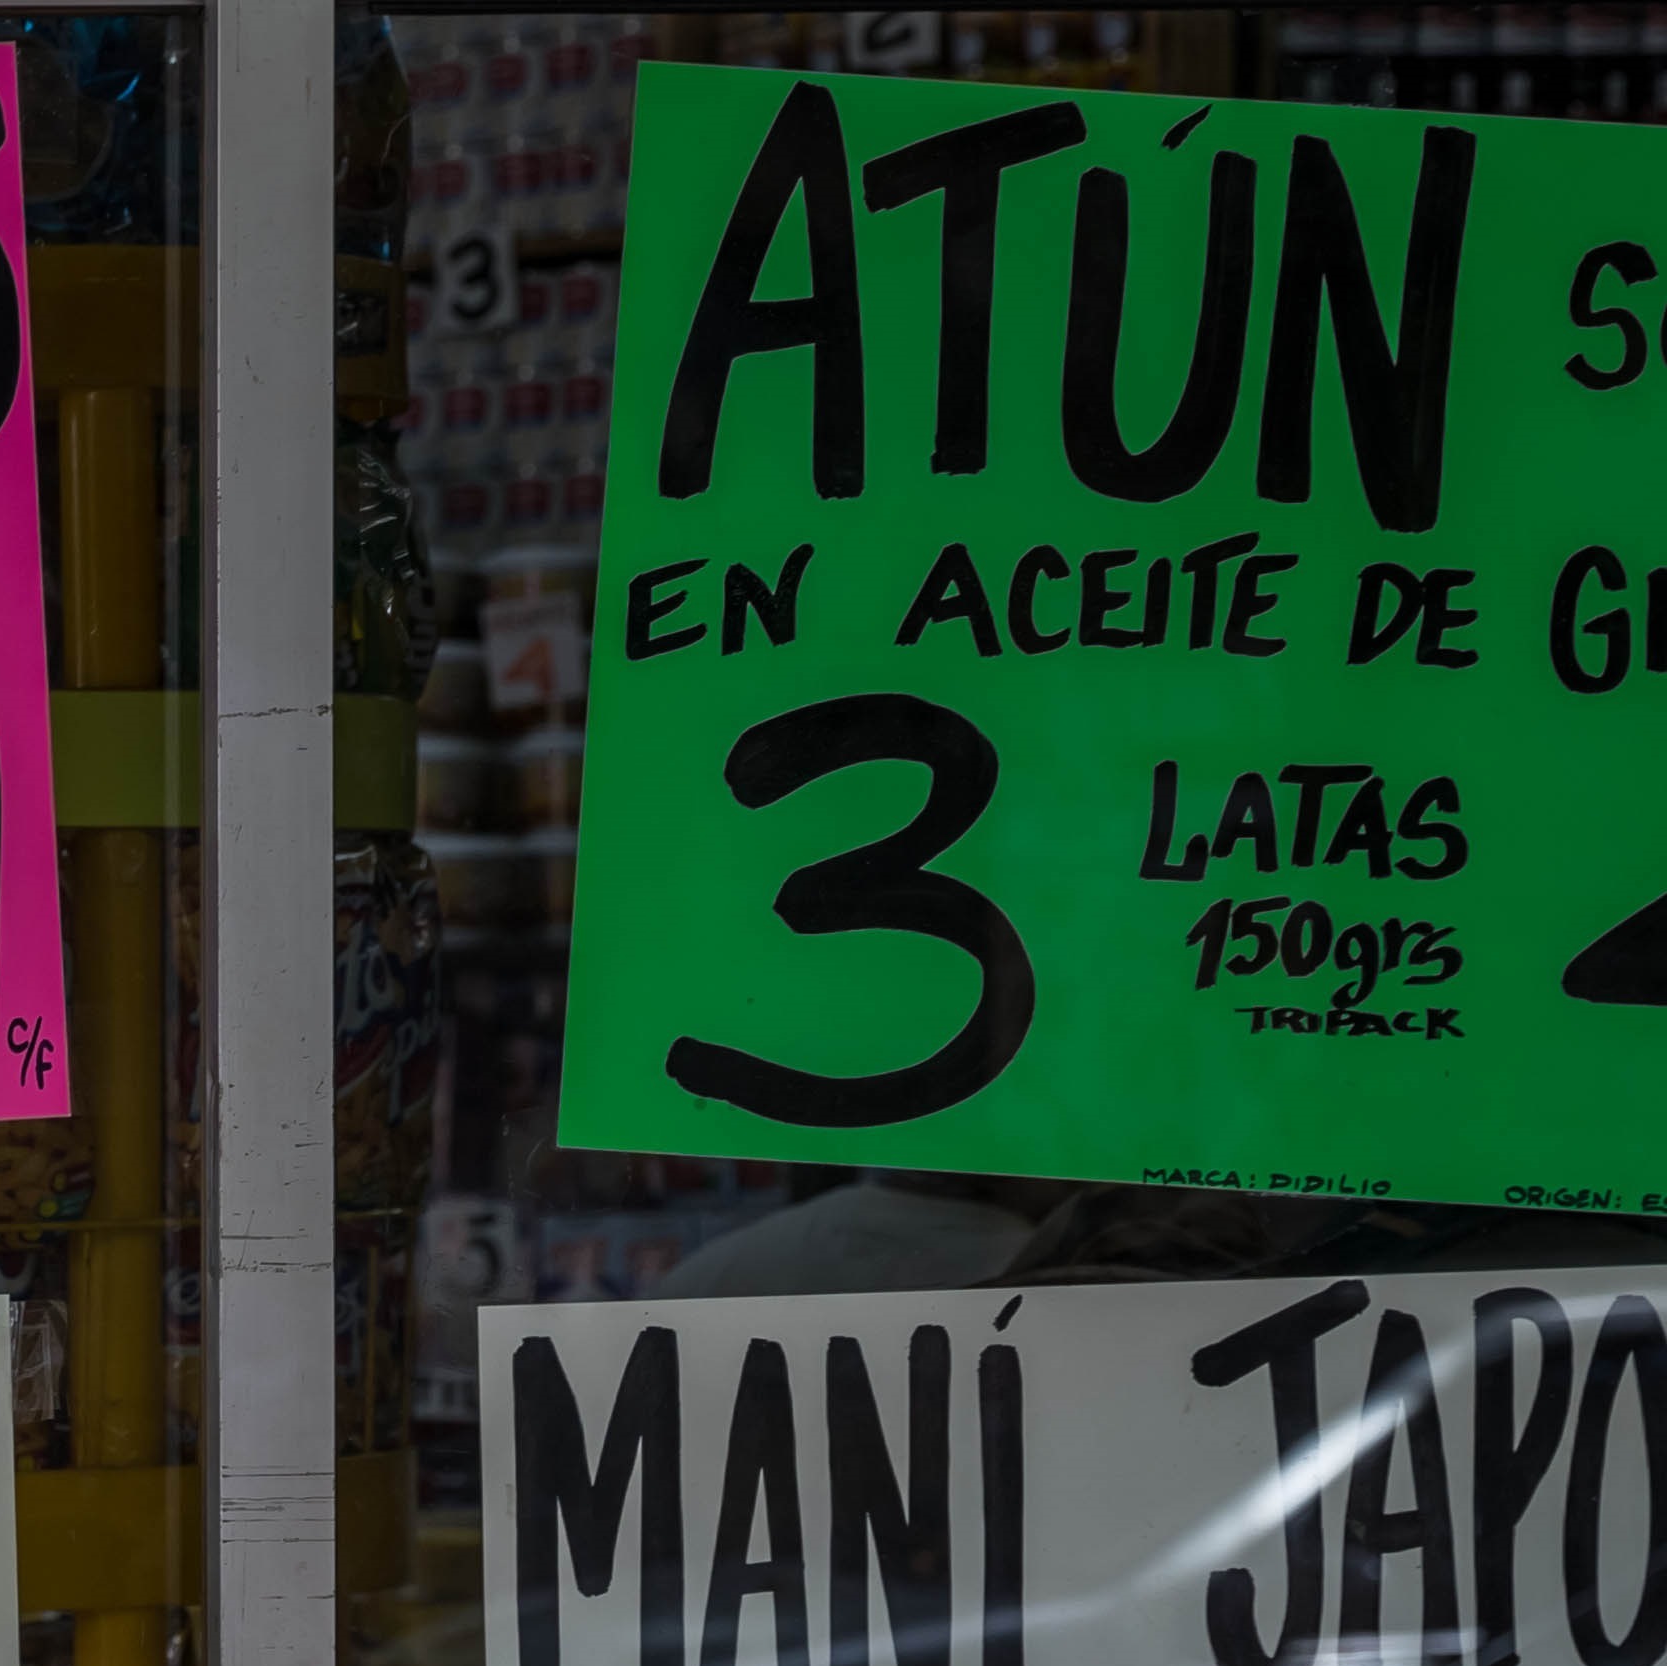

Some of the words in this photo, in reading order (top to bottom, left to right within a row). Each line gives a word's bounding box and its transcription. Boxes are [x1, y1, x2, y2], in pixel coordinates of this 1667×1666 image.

[451, 238, 498, 320] 3
[657, 81, 1477, 533] ATÚN
[1564, 240, 1667, 391] S
[625, 544, 815, 662] EN
[895, 534, 1298, 659] ACEITE
[1347, 562, 1478, 670] DE
[1139, 759, 1469, 881] LATAS
[666, 691, 1036, 1129] 3
[1235, 1005, 1466, 1042] TRIPACK
[1143, 1167, 1257, 1190] MARCA:
[1504, 1185, 1622, 1209] ORIGEN:
